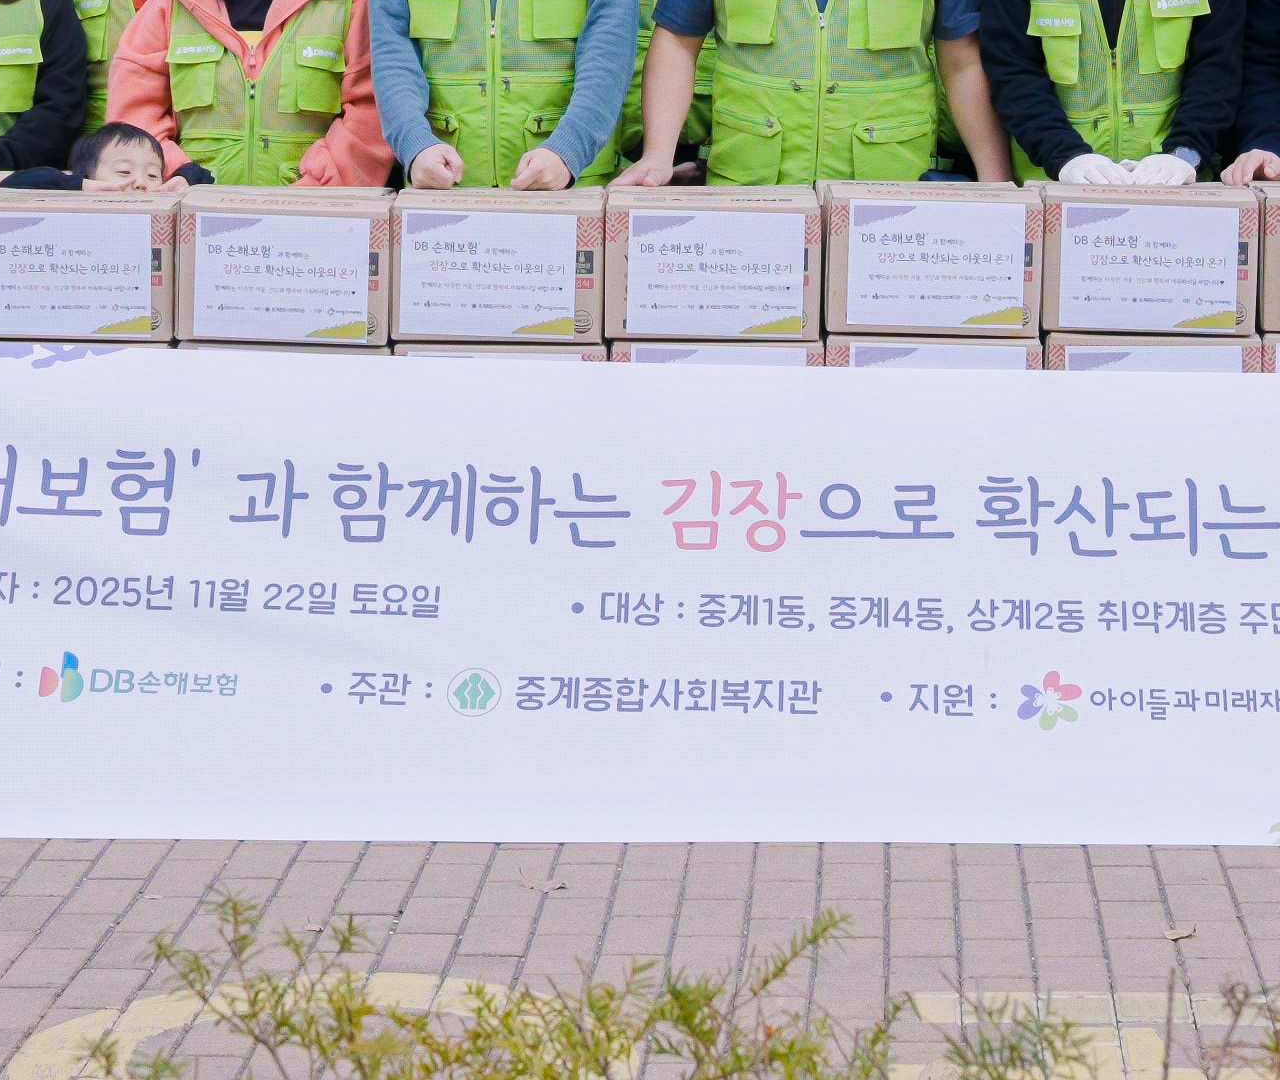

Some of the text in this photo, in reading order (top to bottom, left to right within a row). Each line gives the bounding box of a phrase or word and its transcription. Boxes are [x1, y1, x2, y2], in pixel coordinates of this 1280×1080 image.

[877, 252, 1013, 265] 김장으로 확산되는 이웃의 온기
[1090, 254, 1226, 268] 김장으로 확산되는 이웃의 온기
[8, 263, 140, 274] 김장으로 확산되는 이웃의 온기
[224, 263, 358, 279] 김장으로 확산되는 이웃의 온기
[430, 261, 565, 275] 김장으로 확산되는 이웃의 온기
[656, 262, 792, 274] 김장으로 확산되는 이웃의 온기
[228, 458, 310, 540] 과
[327, 461, 632, 549] 함께하는
[661, 469, 956, 553] 김장으로
[52, 574, 175, 611] 2025년
[189, 578, 250, 613] 11월
[262, 581, 338, 616] 22일
[349, 583, 441, 619] 토요일
[697, 593, 816, 633] 중계1동,
[828, 596, 954, 635] 중계4동,
[966, 598, 1086, 634] 상계2동
[1096, 599, 1228, 635] 취약계층
[90, 668, 238, 697] DB손해보험
[514, 675, 823, 715] 중계종합사회복지관
